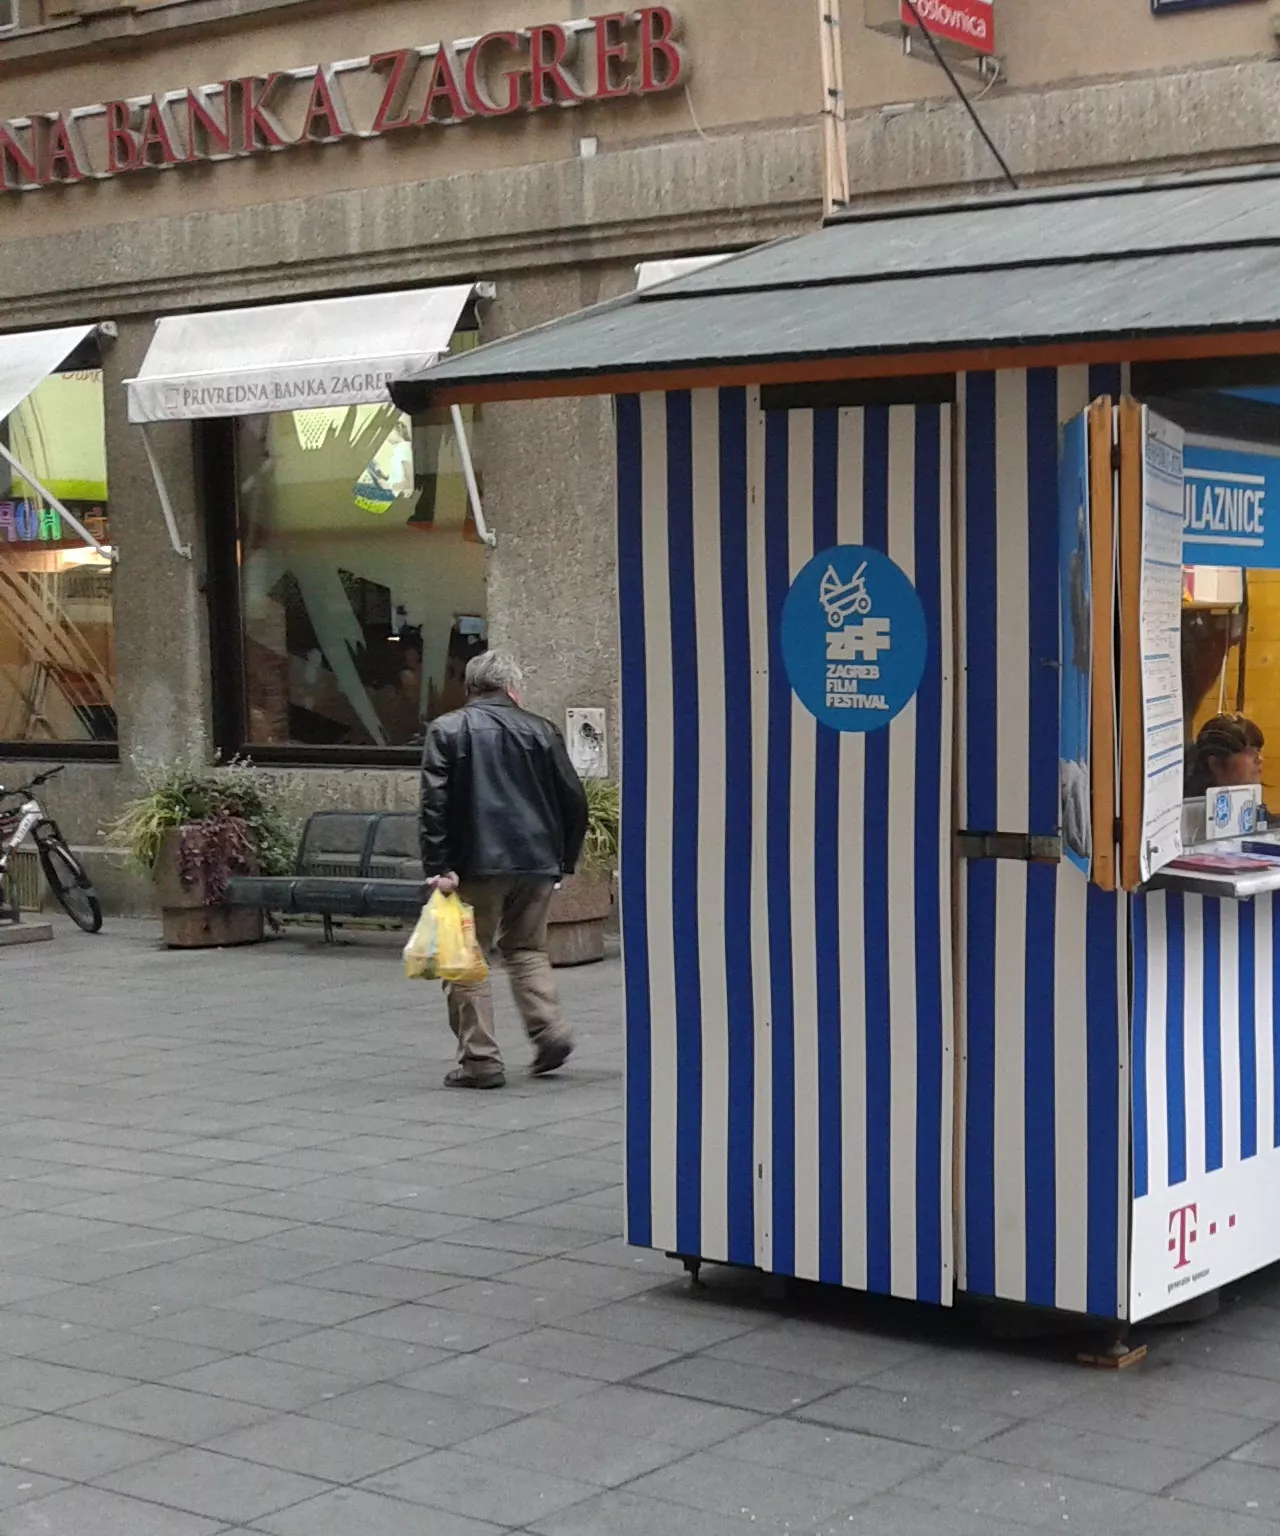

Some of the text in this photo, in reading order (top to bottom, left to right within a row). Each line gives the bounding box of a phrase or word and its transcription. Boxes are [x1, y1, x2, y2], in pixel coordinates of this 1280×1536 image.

[909, 0, 986, 38] oslovnica
[106, 64, 346, 173] BANKA
[369, 5, 683, 132] ZAGREB
[183, 385, 269, 406] PRIVREDNA
[274, 378, 327, 400] BANKA
[826, 664, 880, 679] ZAGREB
[826, 679, 858, 693] FILM
[826, 693, 890, 710] FESTIVAL
